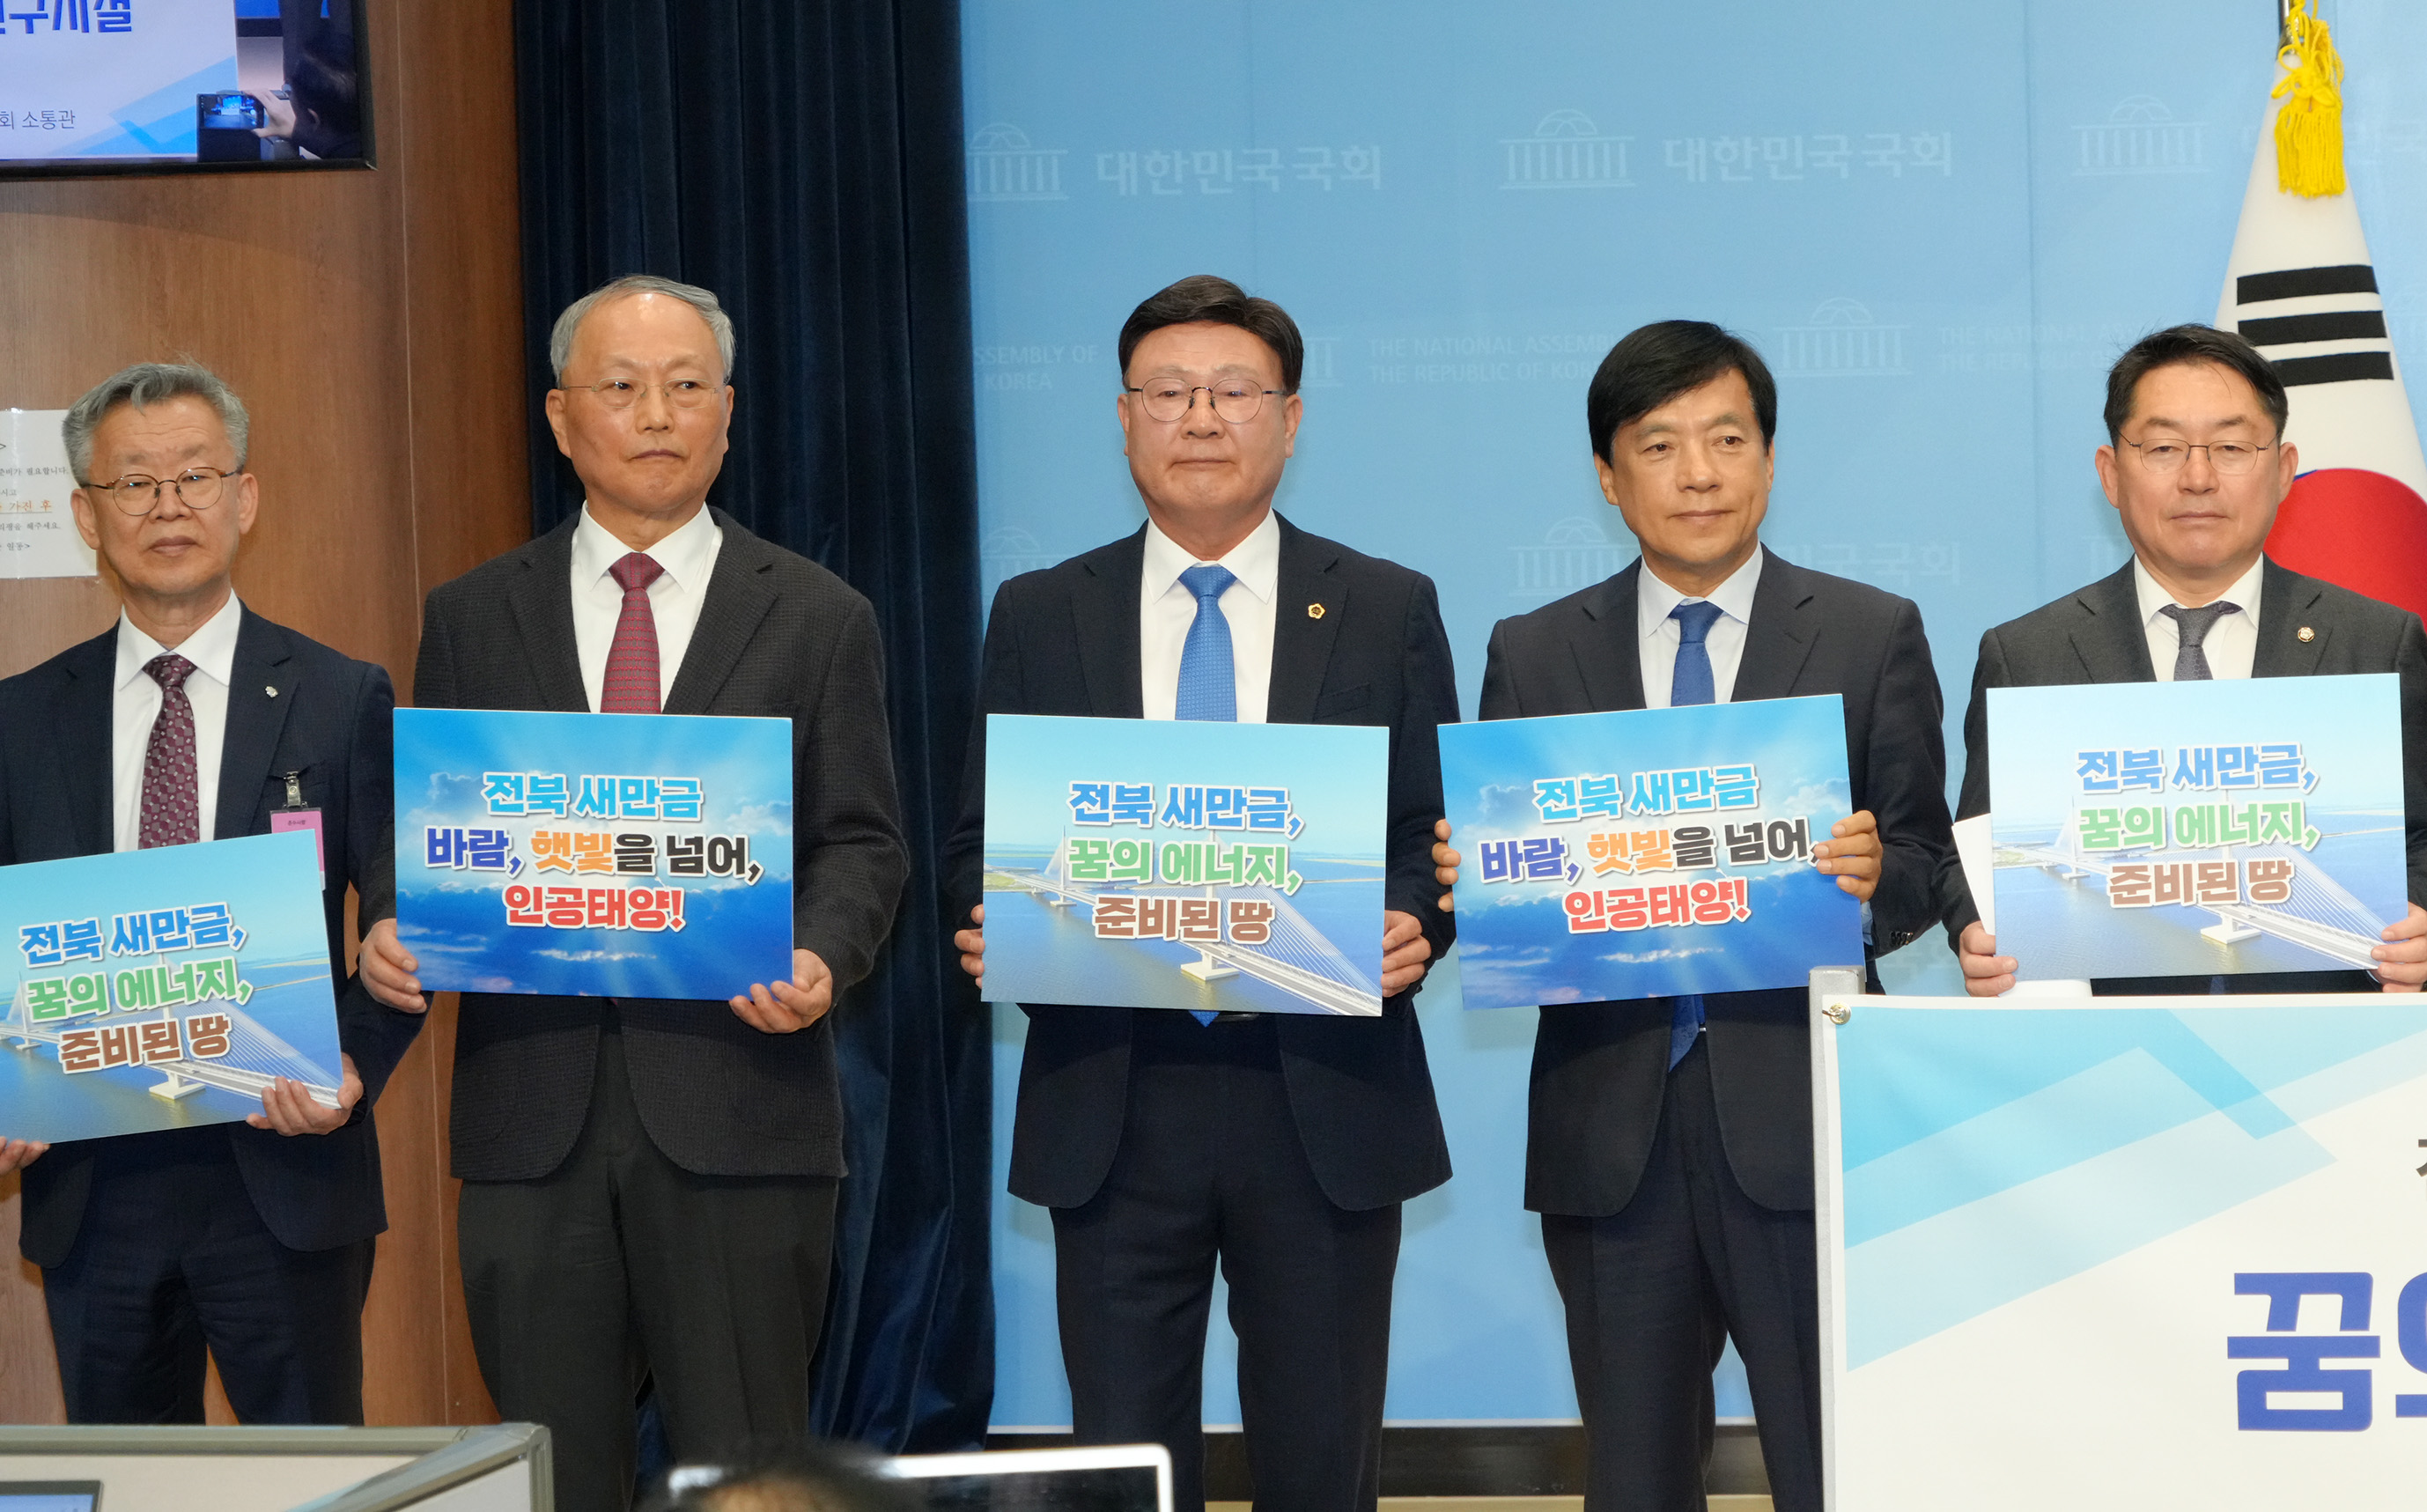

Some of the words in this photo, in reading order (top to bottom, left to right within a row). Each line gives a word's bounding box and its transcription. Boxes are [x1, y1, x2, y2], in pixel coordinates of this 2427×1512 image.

[0, 0, 131, 33] 구시설
[22, 110, 76, 129] 소통관
[1095, 144, 1381, 195] 대한민국국회
[1663, 131, 1952, 182] 대한민국국회
[1072, 344, 1099, 364] OF
[1368, 338, 1406, 358] THE
[1413, 336, 1518, 356] NATIONAL
[1524, 334, 1626, 353] ASSEMB
[984, 372, 1053, 391] KOREA
[1368, 365, 1407, 384] THE
[1414, 363, 1509, 382] REPUBLIC
[1516, 362, 1544, 381] OF
[1551, 361, 1599, 380] KOR
[1534, 775, 1623, 822] 전북
[1629, 764, 1759, 815] 새만금
[2077, 749, 2164, 793] 전북
[2172, 743, 2319, 793] 새만금,
[483, 772, 569, 817] 전북
[576, 775, 702, 821] 새만금
[1068, 782, 1154, 827] 전북
[1161, 785, 1303, 838] 새만금,
[2078, 805, 2165, 851] 꿈의
[2174, 800, 2320, 851] 에너지,
[425, 827, 524, 876] 바람,
[530, 830, 656, 874] 햇빛을
[666, 835, 762, 883] 넘어,
[1068, 839, 1152, 883] 꿈의
[1161, 843, 1303, 894] 에너지,
[1480, 838, 1581, 883] 바람,
[1587, 826, 1716, 875] 햇빛을
[504, 884, 685, 932] 인공태양!
[1563, 879, 1751, 933] 인공태양!
[2110, 861, 2239, 906] 준비된
[2248, 859, 2293, 903] 땅
[20, 918, 103, 966] 전북
[110, 904, 246, 955] 새만금,
[1095, 896, 1221, 940] 준비된
[1229, 899, 1275, 943] 땅
[27, 972, 108, 1021] 꿈의
[116, 958, 252, 1009] 에너지,
[60, 1020, 181, 1072] 준비된
[187, 1014, 231, 1058] 땅
[2227, 1272, 2427, 1433] 꿈
